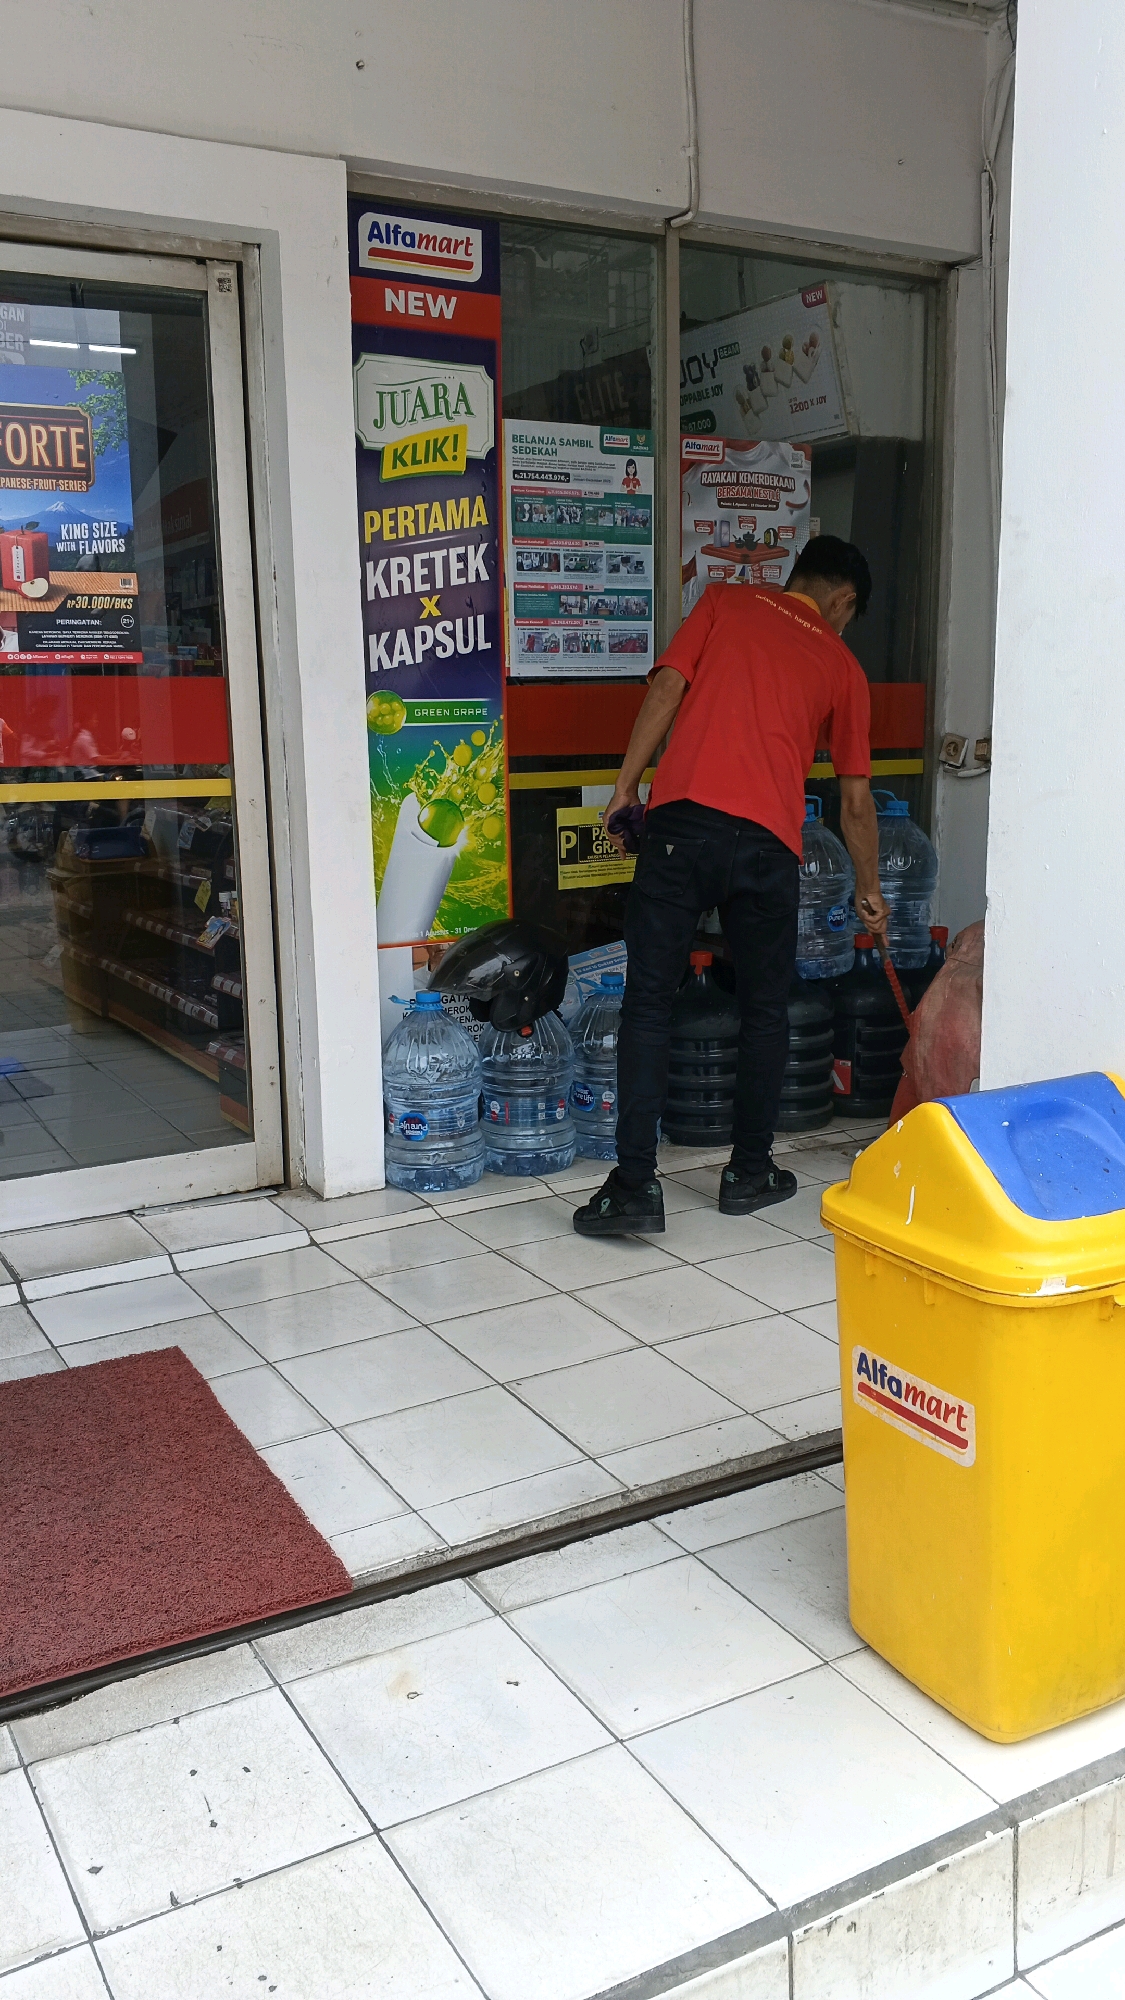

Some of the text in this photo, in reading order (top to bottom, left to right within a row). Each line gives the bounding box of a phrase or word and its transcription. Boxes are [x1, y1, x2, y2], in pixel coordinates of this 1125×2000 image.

[367, 220, 474, 256] Alfamart
[384, 287, 458, 320] NEW
[805, 289, 824, 304] NEW
[719, 344, 740, 358] BEAM
[711, 383, 725, 397] JOY
[373, 380, 477, 430] JUARA
[789, 401, 810, 414] 1200
[816, 395, 827, 405] JOY
[0, 421, 87, 469] ORTE
[512, 434, 594, 449] BELANJA SAMBIL
[604, 435, 629, 443] Alfamart
[684, 441, 720, 452] Alfamart
[391, 435, 462, 471] KLIK!
[512, 446, 558, 457] SEDEKAH
[33, 478, 57, 491] FRUIT
[59, 480, 88, 492] SERIES
[701, 471, 795, 490] RAYAKAN KEMERDEKAAN
[717, 485, 753, 499] BERSAMA
[363, 495, 490, 545] PERTAMA
[61, 523, 89, 541] KING
[92, 521, 118, 538] SIZE
[56, 538, 126, 556] WITH FLAVORS
[365, 543, 491, 602] KRETEK
[794, 614, 811, 629] harga
[811, 626, 823, 635] pas
[367, 615, 493, 673] KAPSUL
[413, 707, 488, 717] GREEN GRAPE
[560, 830, 578, 859] P
[856, 1352, 968, 1432] Alfamart
